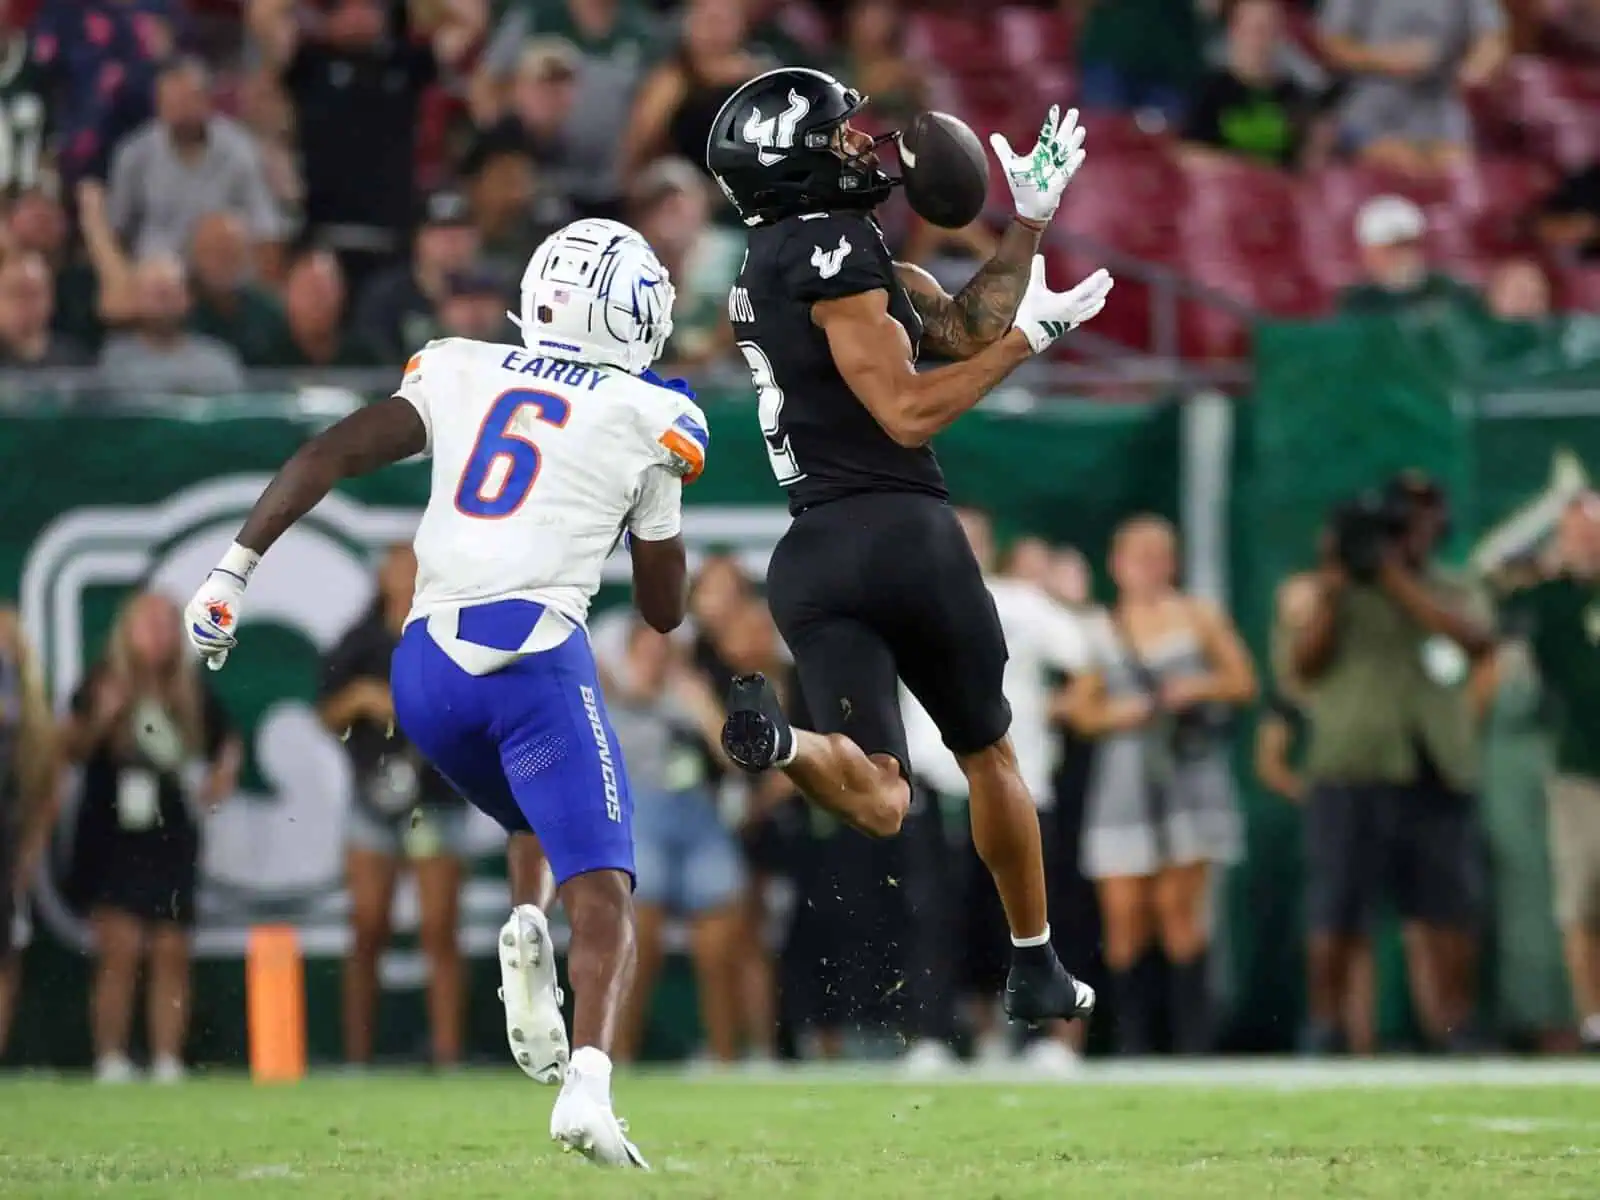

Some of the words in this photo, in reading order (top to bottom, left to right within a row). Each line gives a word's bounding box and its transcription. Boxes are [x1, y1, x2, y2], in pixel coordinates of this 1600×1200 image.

[501, 351, 611, 391] EARBY
[454, 387, 571, 520] 6
[580, 684, 622, 824] BRONCOS
